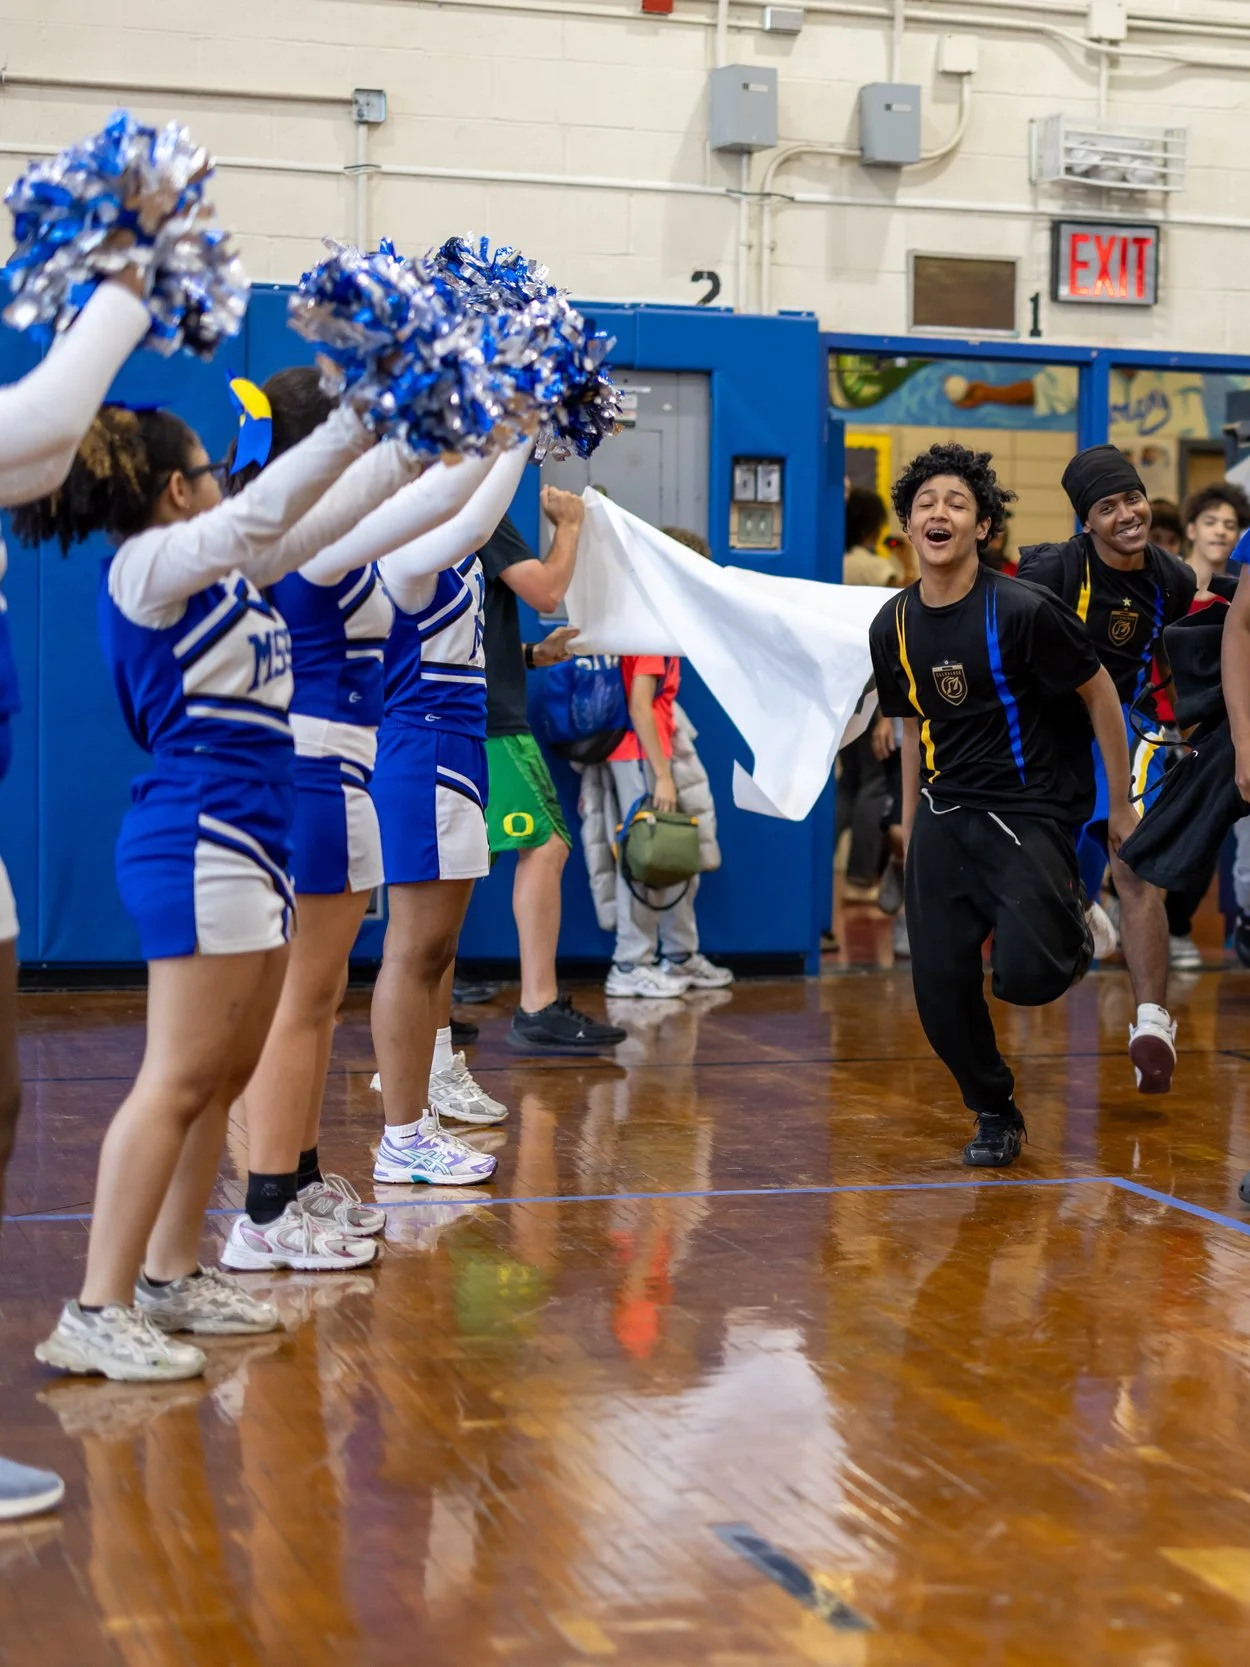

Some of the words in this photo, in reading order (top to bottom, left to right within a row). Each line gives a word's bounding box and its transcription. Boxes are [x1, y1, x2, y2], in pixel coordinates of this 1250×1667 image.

[690, 270, 721, 306] 2
[1068, 232, 1153, 299] EXIT
[1029, 292, 1042, 337] 1
